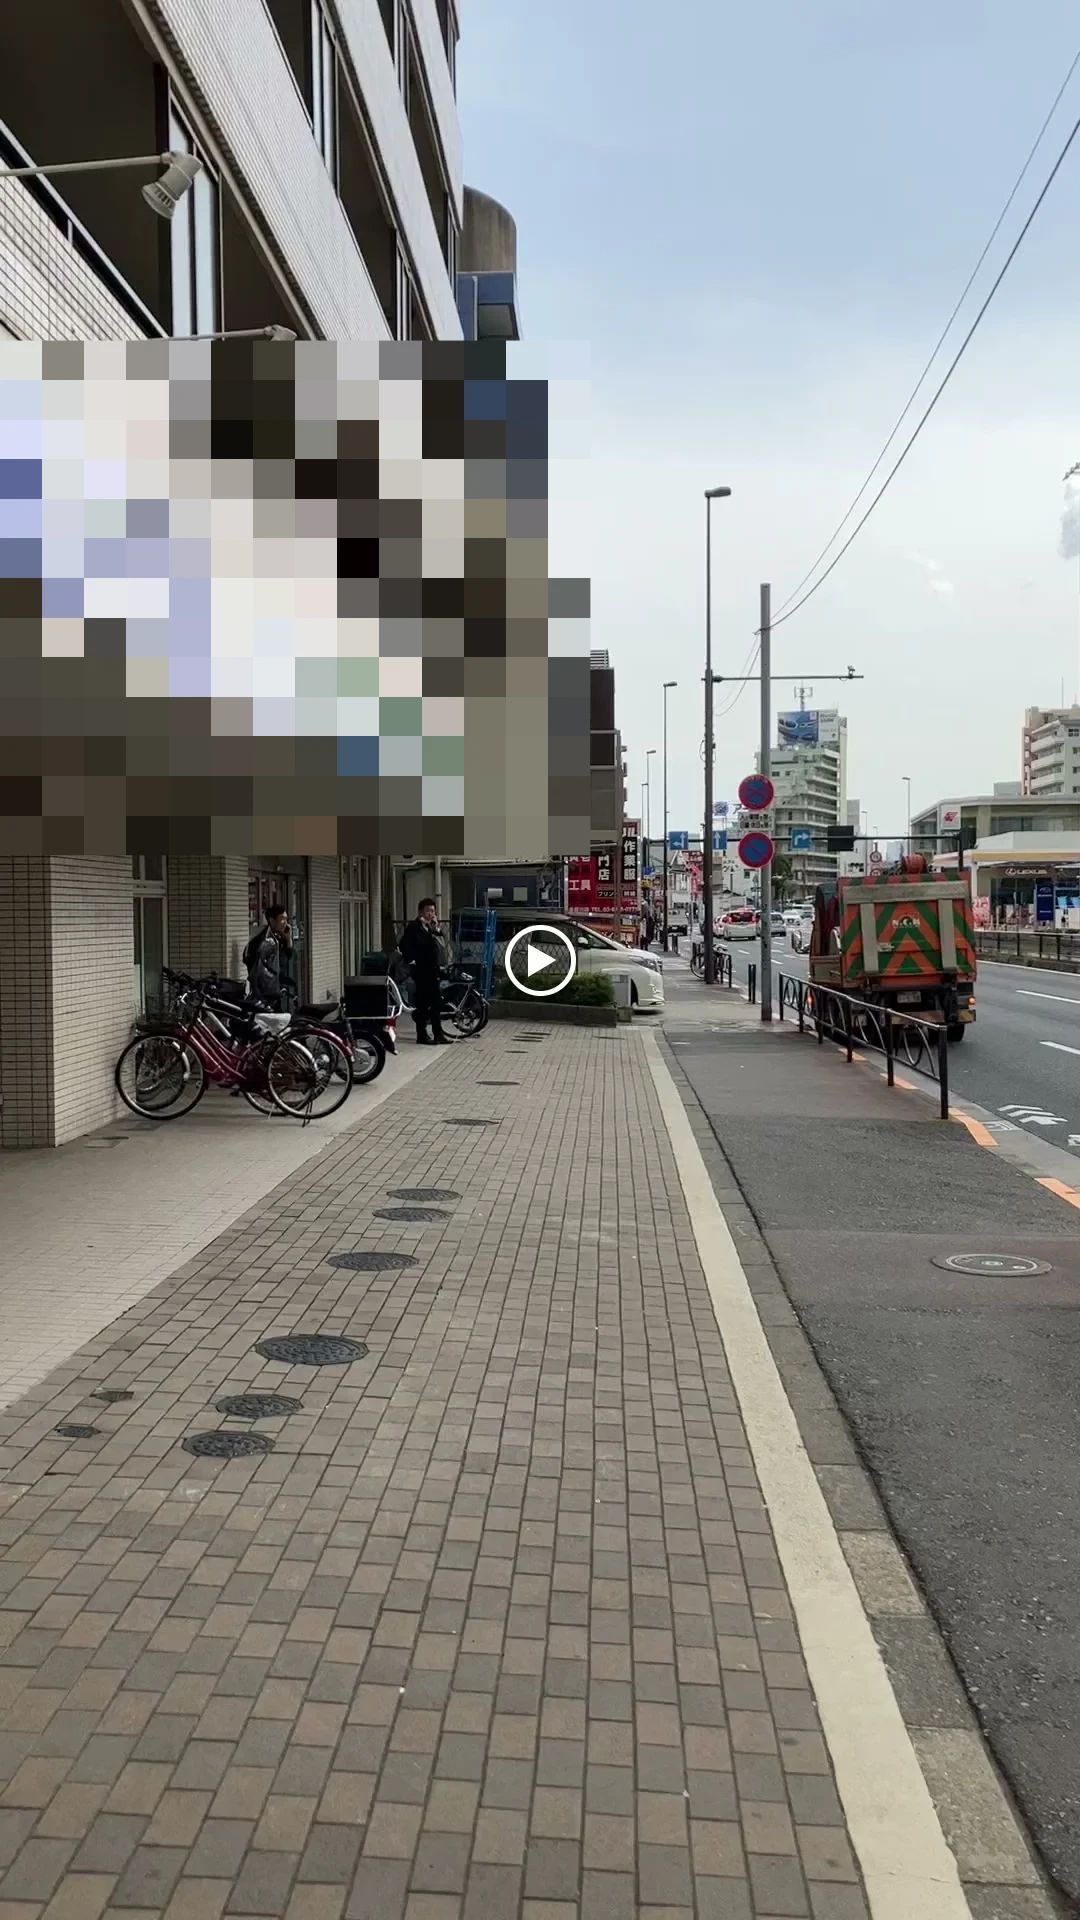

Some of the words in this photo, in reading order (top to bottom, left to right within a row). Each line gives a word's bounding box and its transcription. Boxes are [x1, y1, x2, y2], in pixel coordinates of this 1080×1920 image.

[623, 840, 637, 881] 作業服
[568, 879, 592, 891] 工具
